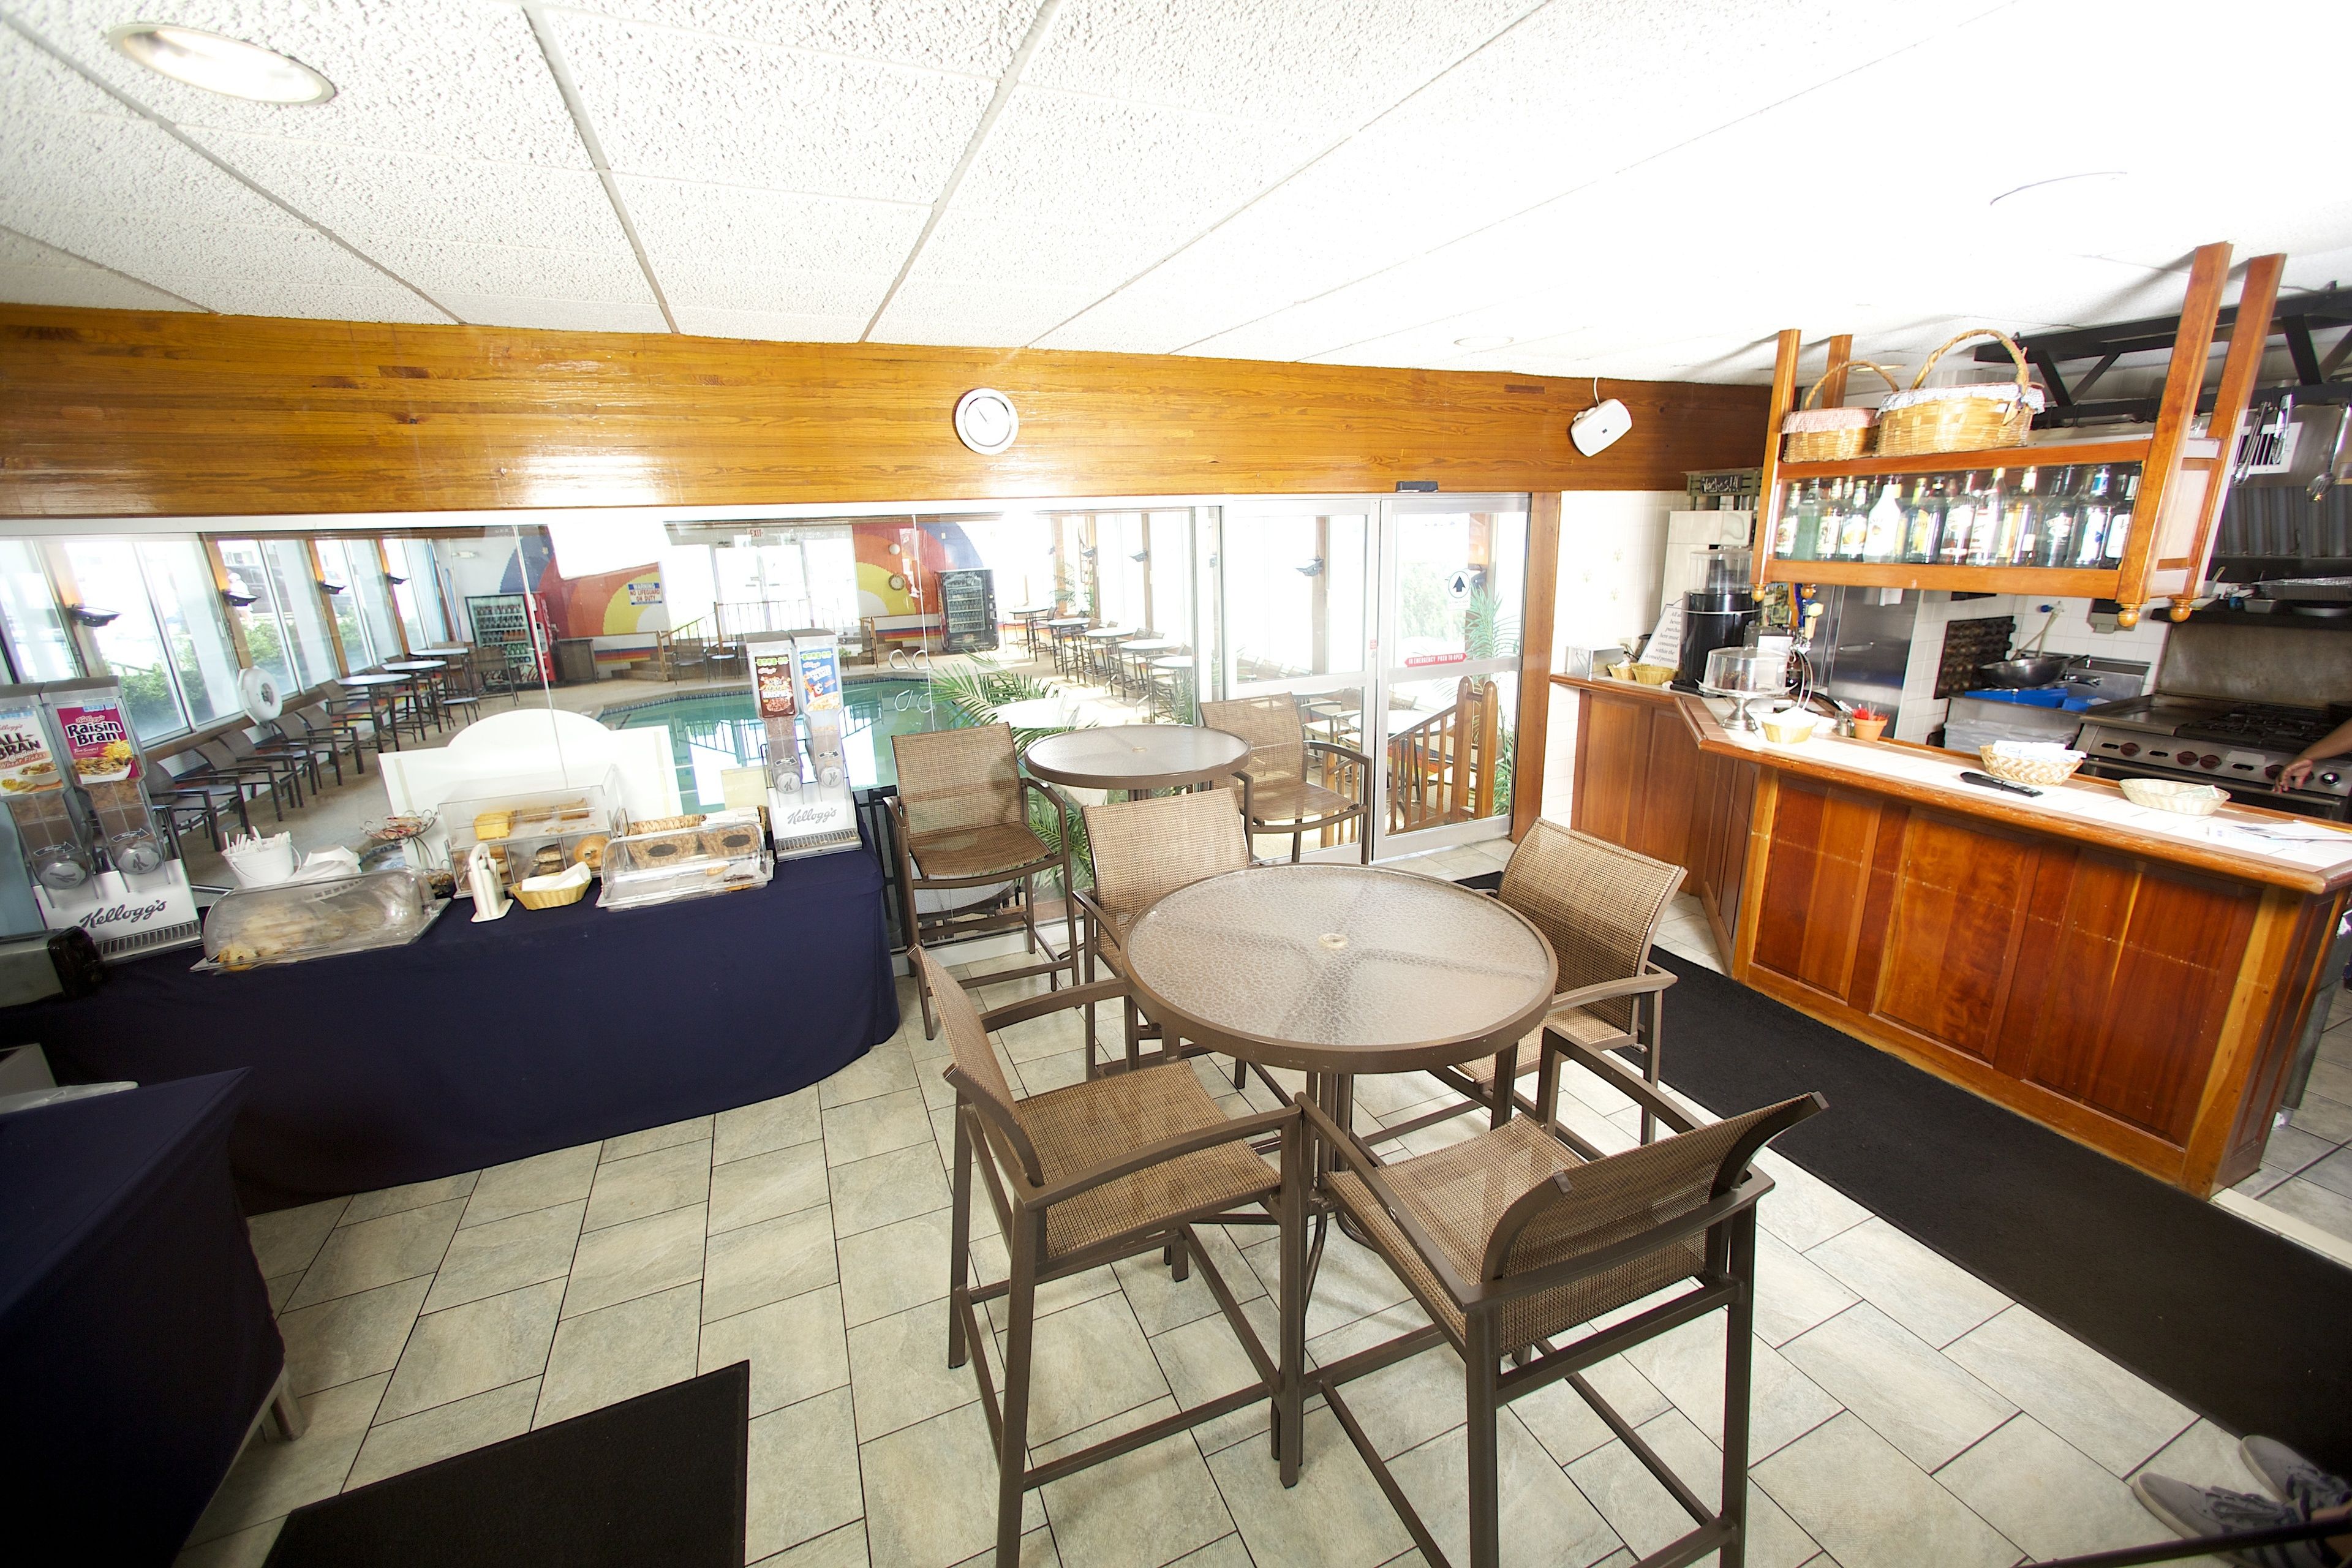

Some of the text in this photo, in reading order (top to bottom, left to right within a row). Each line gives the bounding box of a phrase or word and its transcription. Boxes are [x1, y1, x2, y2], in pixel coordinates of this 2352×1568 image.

[67, 722, 120, 737] Raisin
[77, 732, 118, 745] Bran
[787, 808, 837, 824] Kellogg's
[80, 899, 167, 929] Kellogg's
